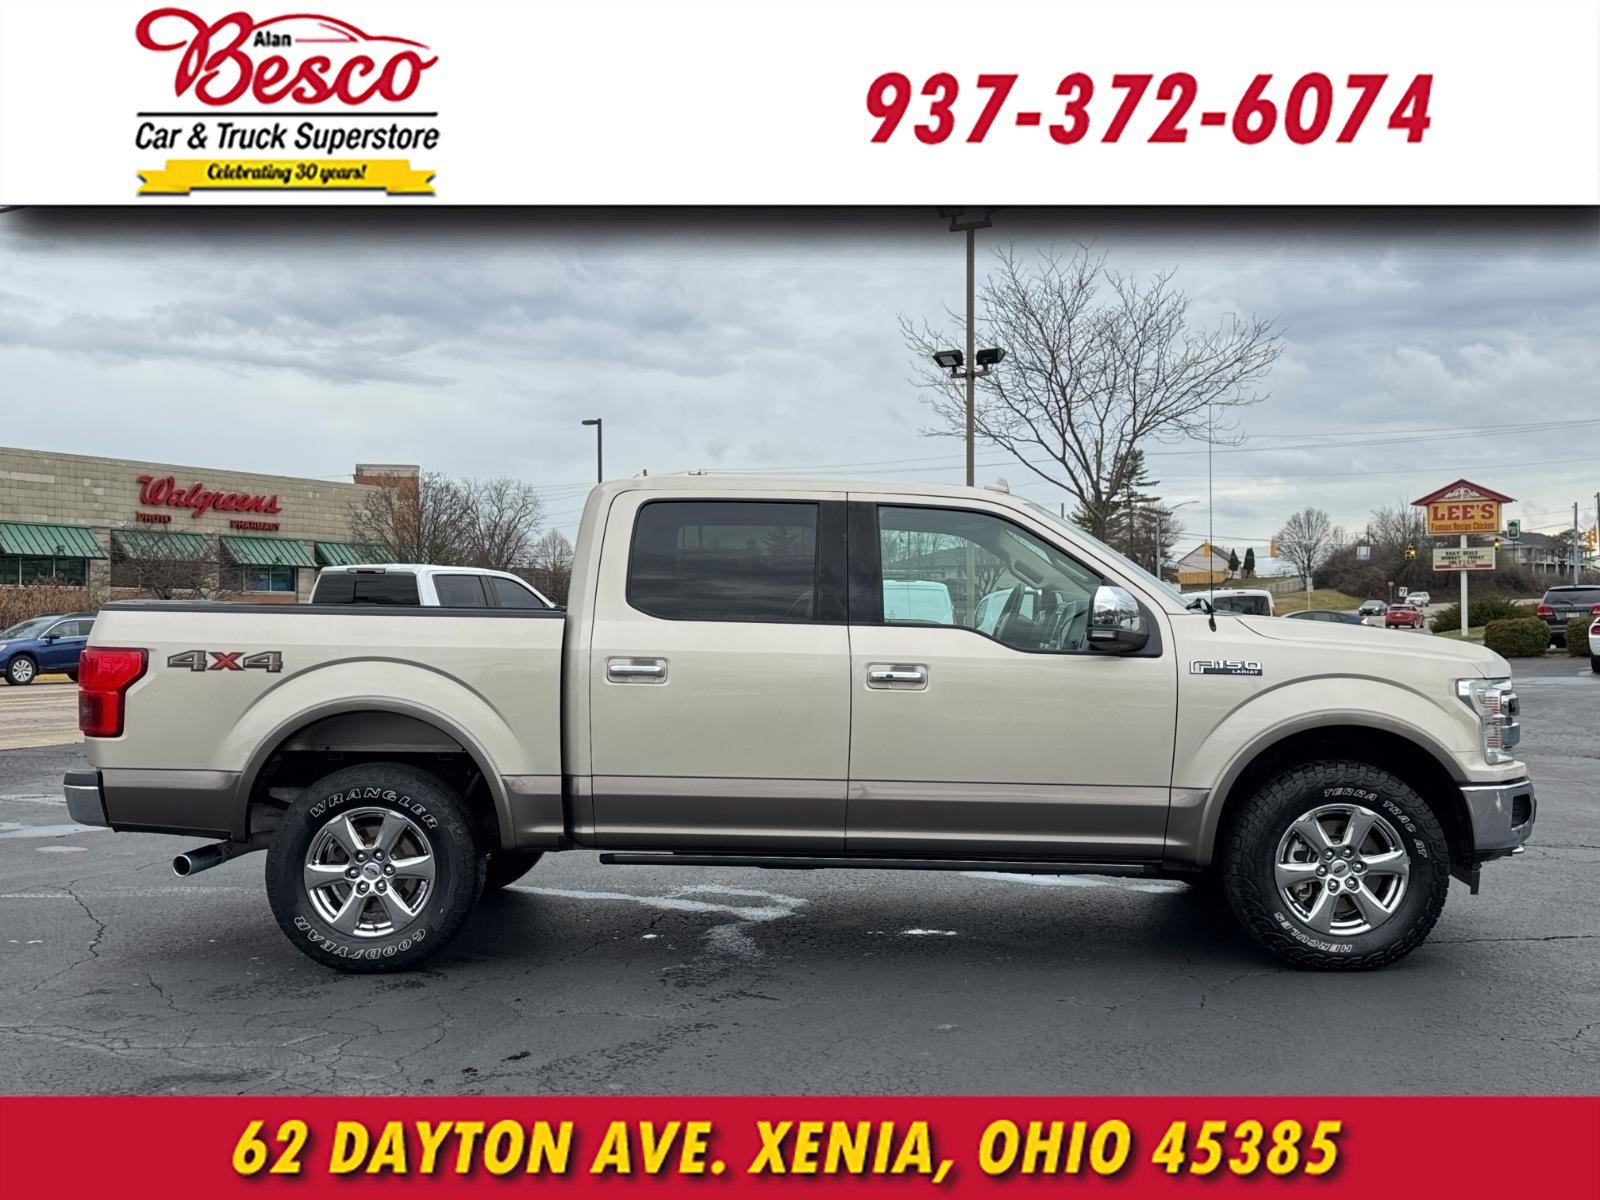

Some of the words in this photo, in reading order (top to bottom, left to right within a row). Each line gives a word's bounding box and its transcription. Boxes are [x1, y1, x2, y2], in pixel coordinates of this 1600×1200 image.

[137, 475, 282, 518] Walgreens
[1432, 504, 1495, 521] LEE'S
[135, 512, 172, 524] PHOTO
[230, 520, 280, 531] PHARMACY
[309, 787, 439, 829] WRANGLER
[1323, 787, 1378, 802] TERRA
[1382, 800, 1416, 833] TRAC
[294, 916, 426, 960] GOODYEAR
[1273, 911, 1353, 953] HERCULES
